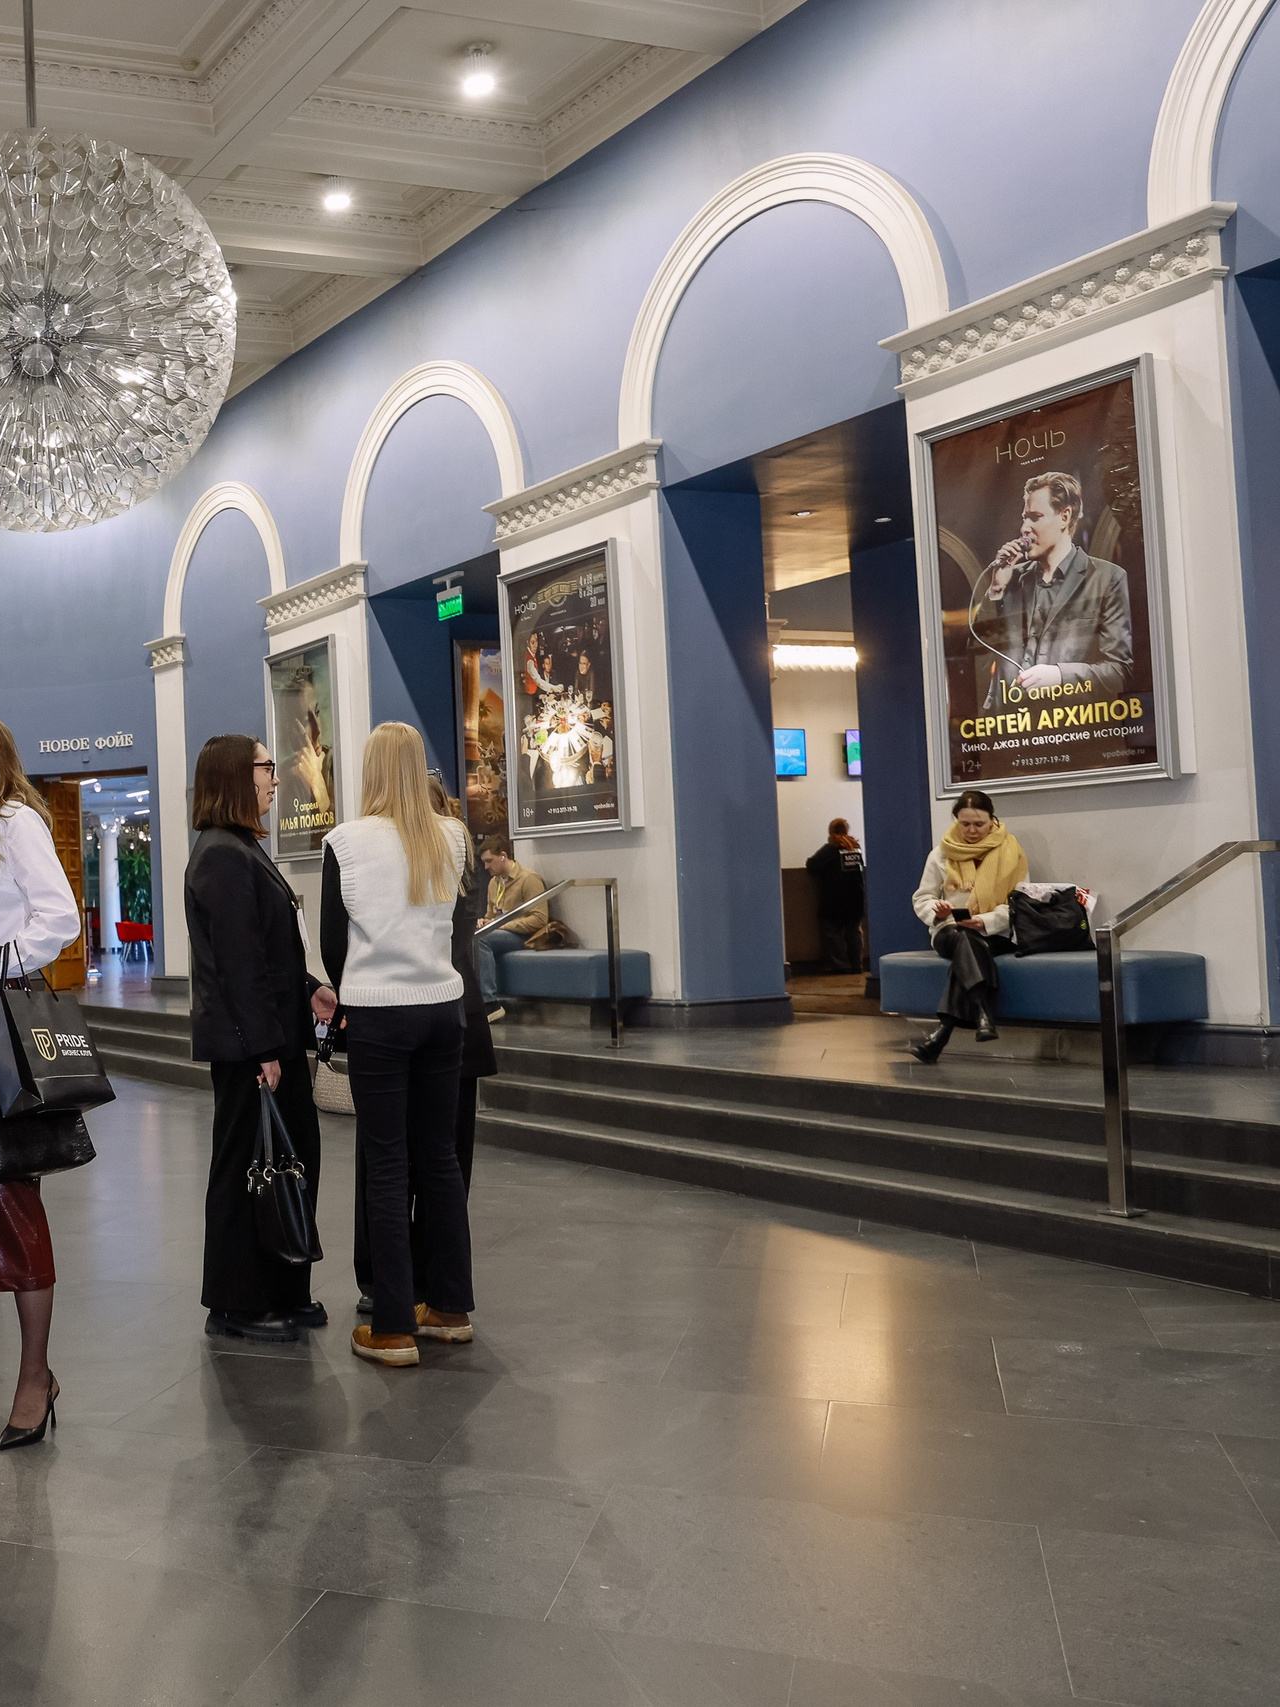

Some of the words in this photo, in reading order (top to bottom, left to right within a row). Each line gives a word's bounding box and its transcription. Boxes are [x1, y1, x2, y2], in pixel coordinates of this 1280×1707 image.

[995, 429, 1066, 464] НОЧЬ
[514, 601, 537, 615] НОЧЬ
[999, 679, 1023, 704] 16
[1028, 680, 1092, 701] апреля
[959, 707, 1032, 739] СЕРГЕЙ
[1037, 698, 1144, 731] АРХИПОВ
[39, 737, 90, 753] НОВОЕ
[94, 731, 134, 750] ФОЙЕ
[992, 738, 1021, 751] джаз
[1022, 738, 1030, 747] и
[1031, 731, 1091, 746] авторские
[1093, 724, 1144, 739] истории
[960, 759, 982, 773] 12+
[1011, 759, 1020, 767] +7
[1020, 757, 1034, 766] 913
[1034, 754, 1071, 765] 377-19-78
[293, 798, 299, 812] 9
[522, 807, 535, 818] 18+
[280, 816, 299, 831] ИЛЬЯ
[300, 811, 335, 829] ПОЛЯКОВ
[54, 1033, 90, 1048] PRIDE
